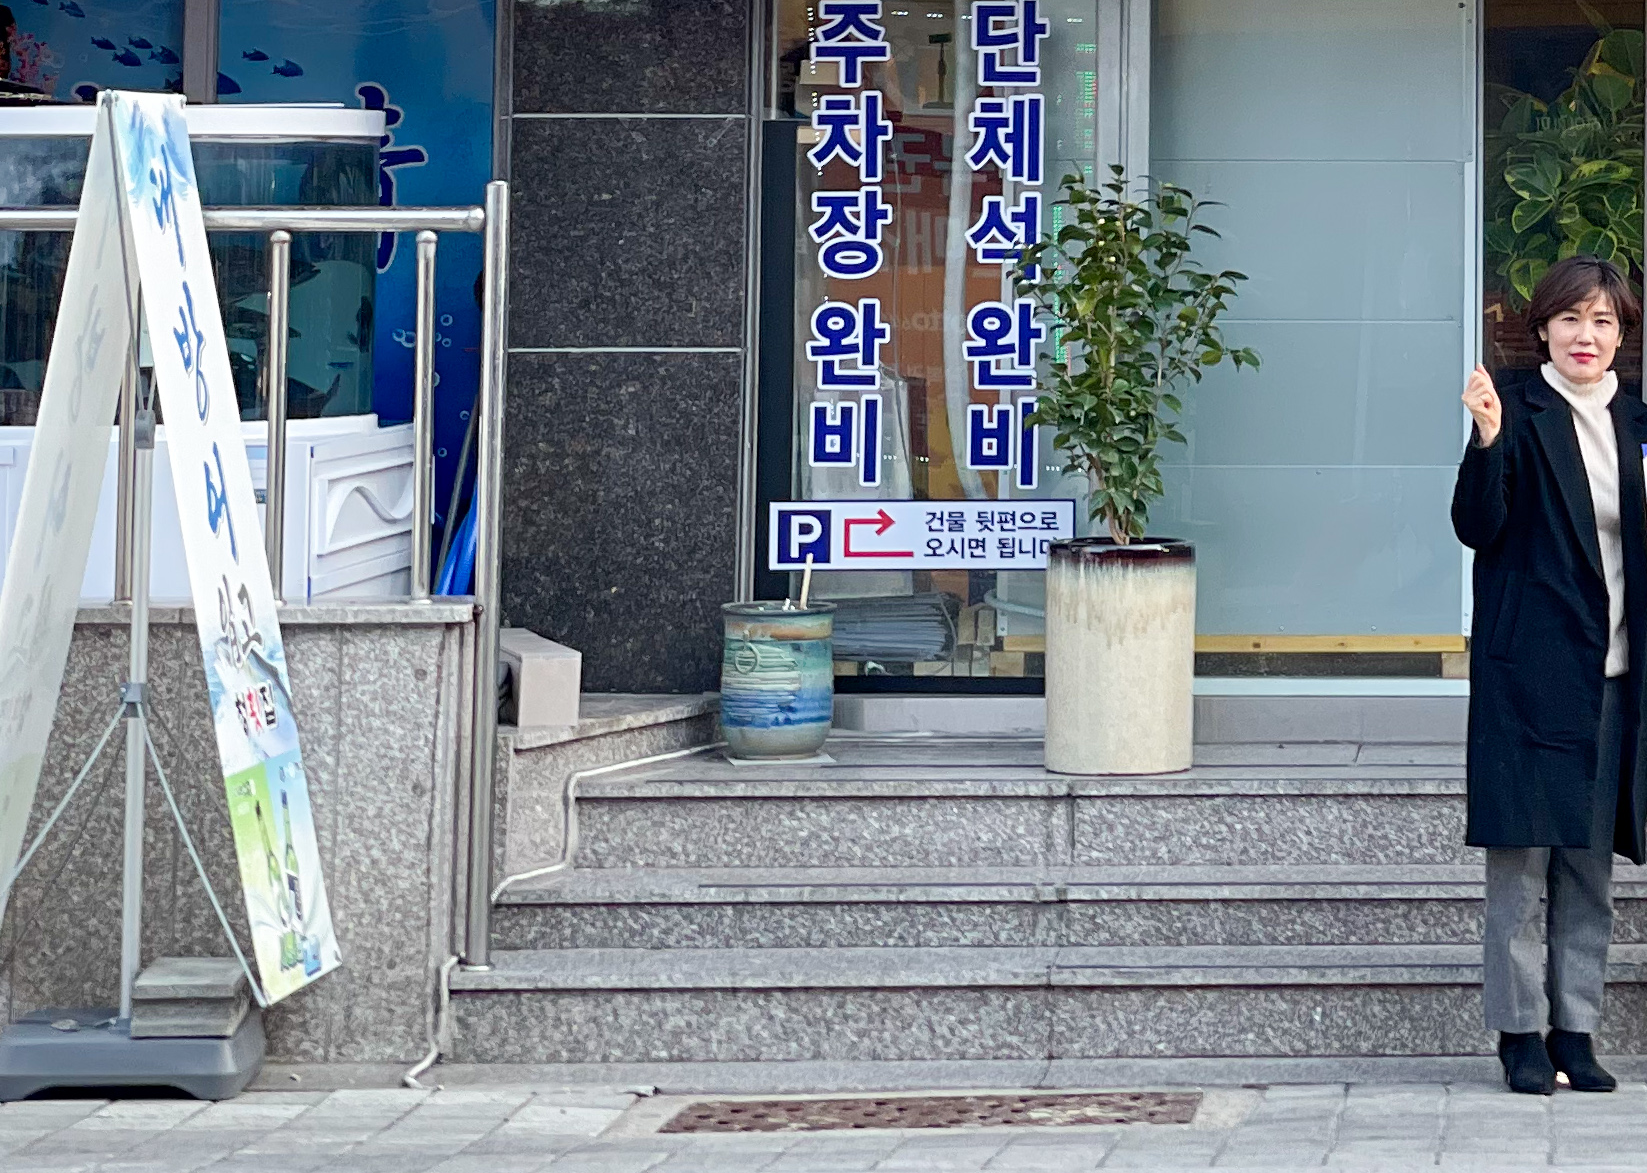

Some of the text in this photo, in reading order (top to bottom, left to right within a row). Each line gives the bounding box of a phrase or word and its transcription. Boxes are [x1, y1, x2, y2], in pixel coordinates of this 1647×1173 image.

[806, 299, 889, 488] 완비
[963, 300, 1048, 491] 완비
[790, 514, 822, 558] P
[924, 510, 1060, 532] 건물 뒷편으로
[924, 537, 987, 559] 오시면
